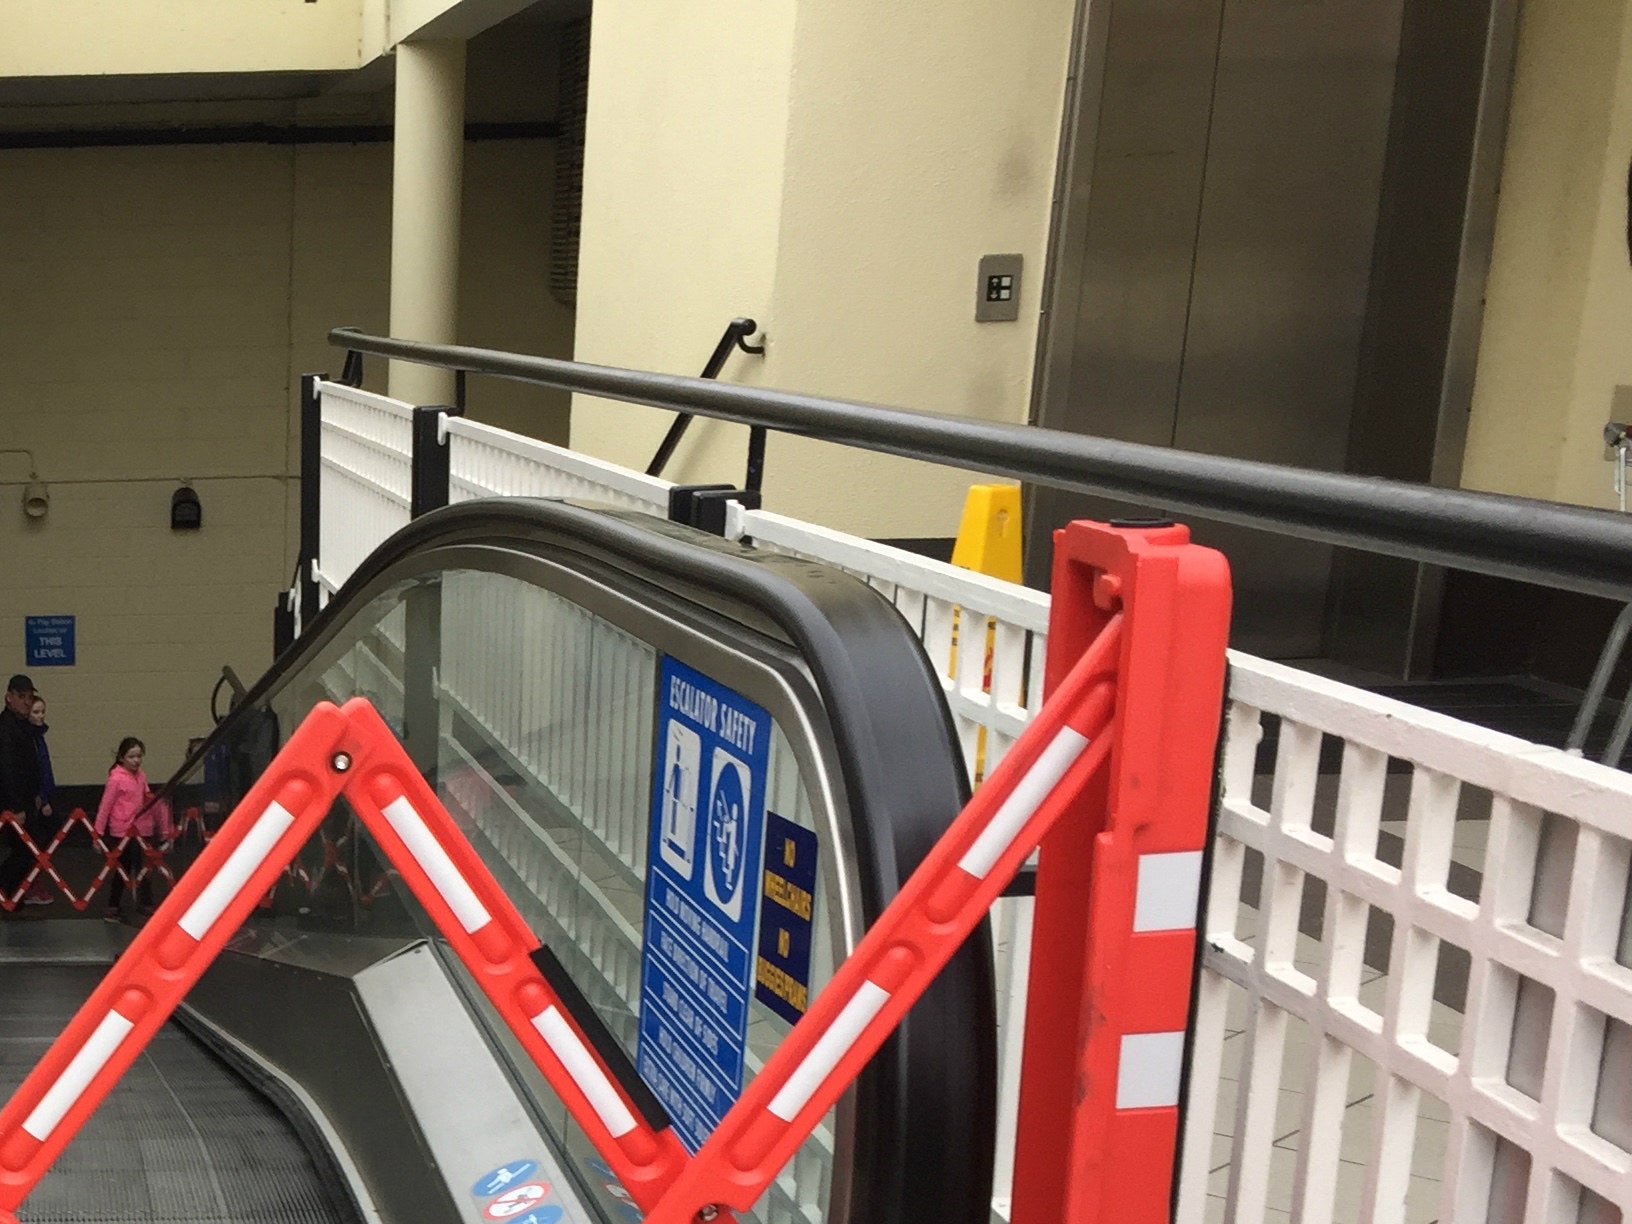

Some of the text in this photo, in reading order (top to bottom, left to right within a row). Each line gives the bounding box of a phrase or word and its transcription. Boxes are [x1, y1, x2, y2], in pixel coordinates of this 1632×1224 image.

[39, 637, 62, 645] THIS
[34, 649, 66, 658] LEVEL
[669, 675, 756, 755] ESCALATOR SAFETY
